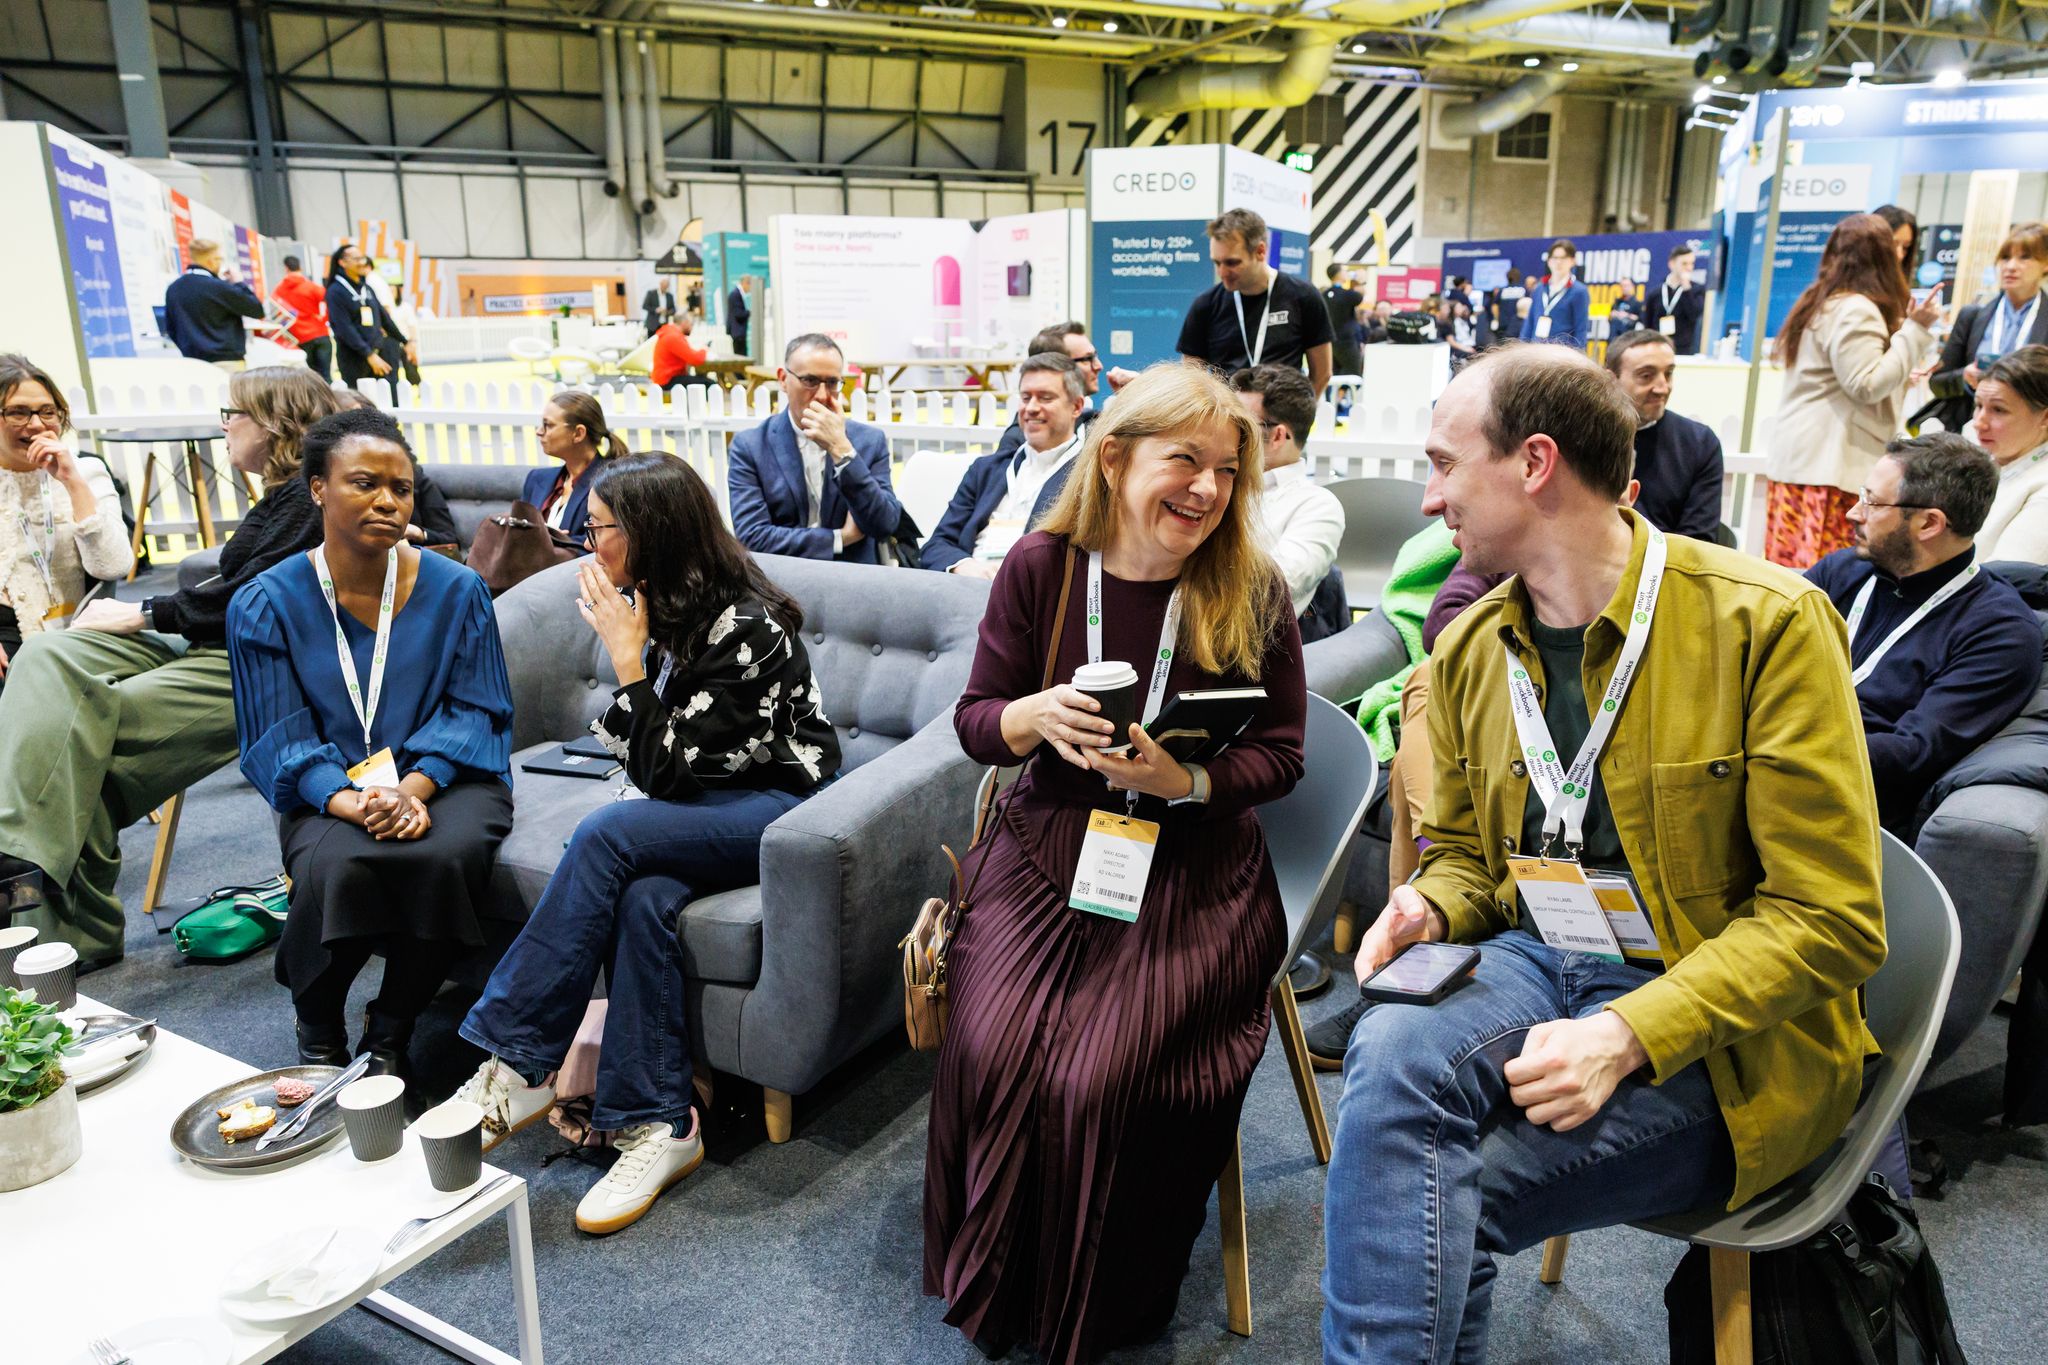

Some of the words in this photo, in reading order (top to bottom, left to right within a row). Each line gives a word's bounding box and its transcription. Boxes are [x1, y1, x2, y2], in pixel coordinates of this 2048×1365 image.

[1905, 100, 1981, 123] STRIDE
[1039, 120, 1097, 176] 17
[1113, 172, 1196, 193] CREDO
[1780, 178, 1847, 197] REDO
[1112, 237, 1149, 249] Trusted
[1151, 237, 1166, 250] by
[1112, 251, 1173, 264] accounting
[1175, 250, 1201, 262] firms
[1645, 575, 1658, 612] quickbooks
[1152, 659, 1163, 693] quickbooks
[1615, 660, 1634, 700] quickbooks
[1515, 681, 1533, 718] quickbooks
[1574, 748, 1597, 784] quickbooks
[1103, 860, 1125, 868] DIRECTOR
